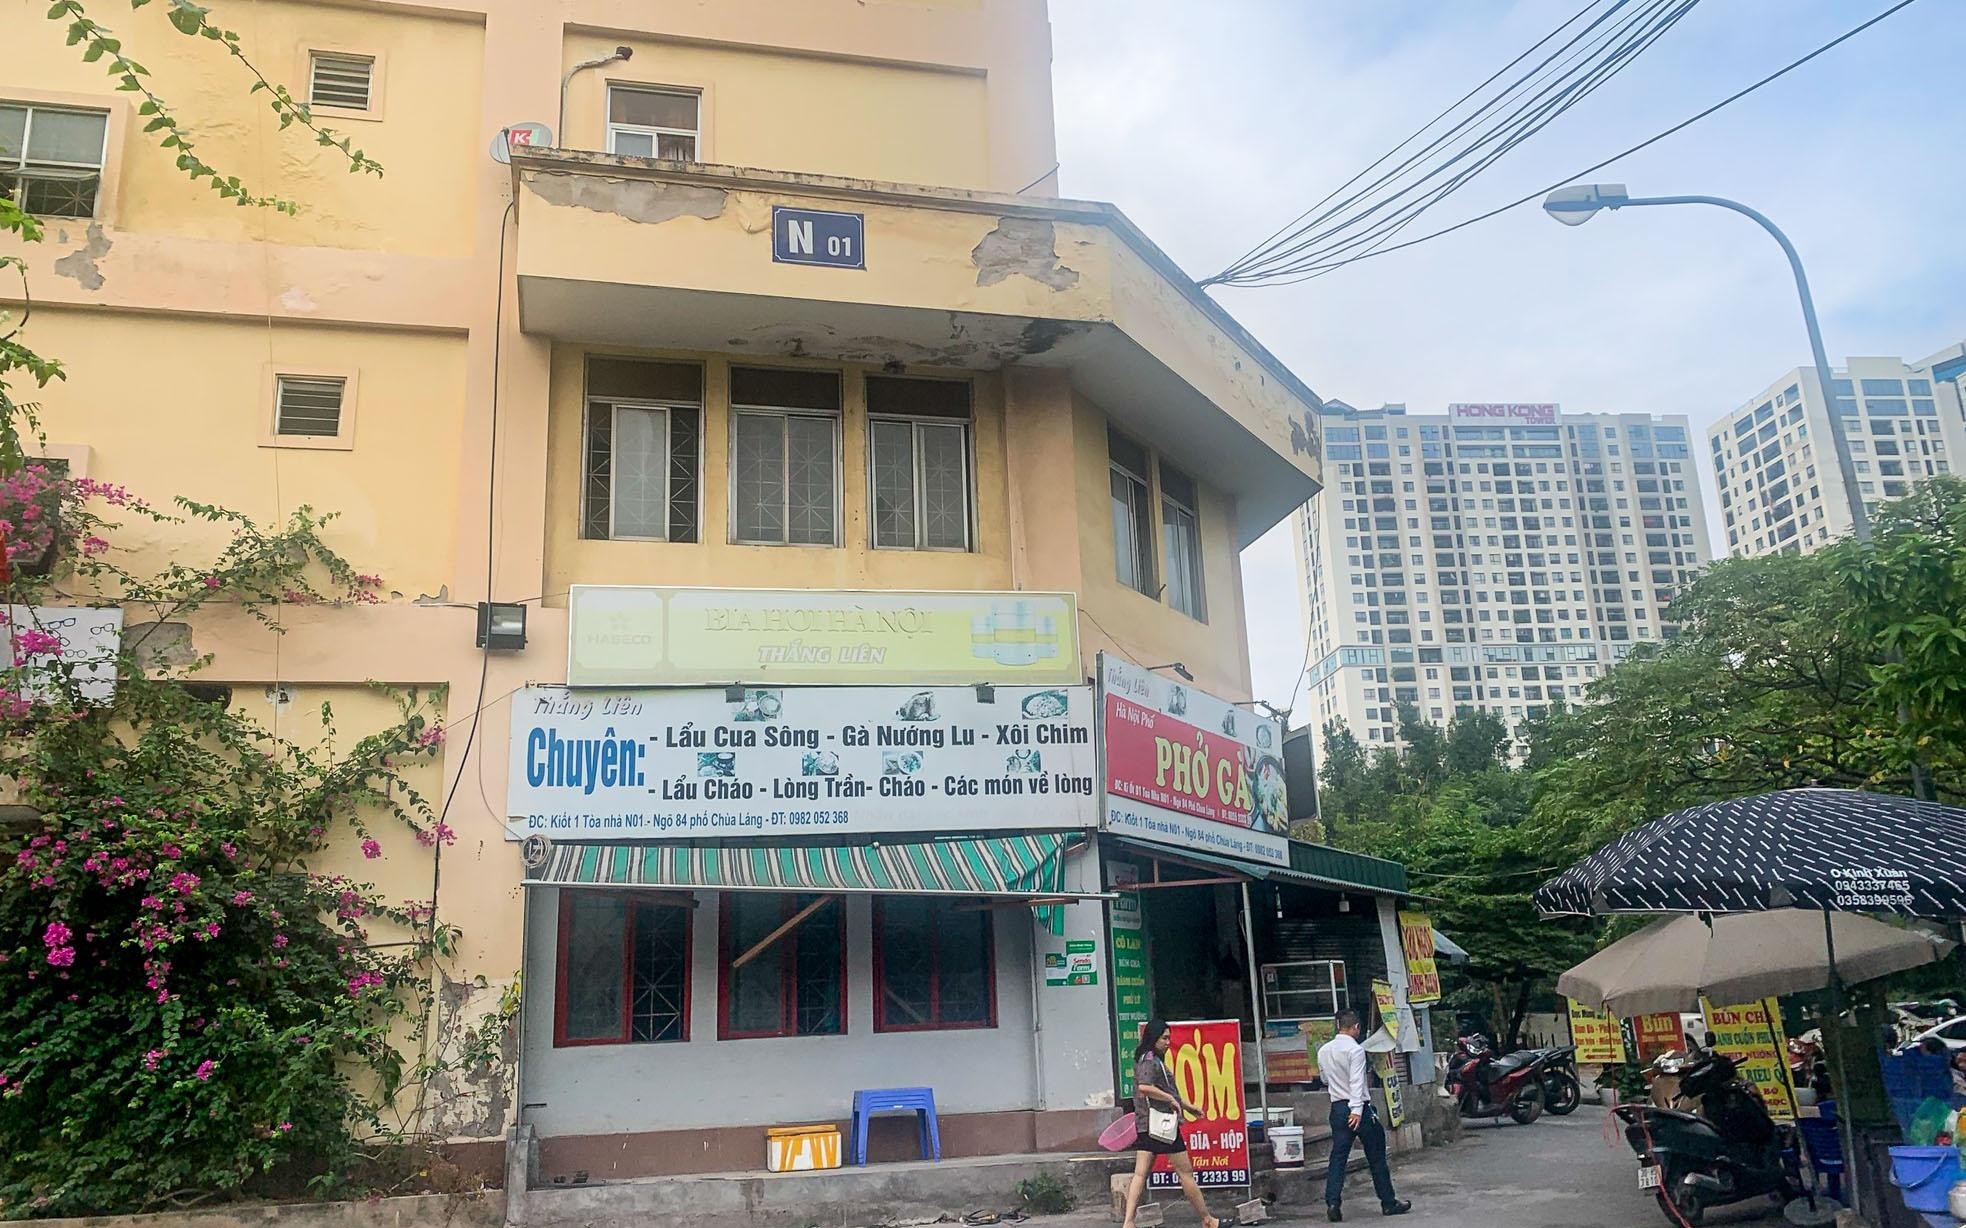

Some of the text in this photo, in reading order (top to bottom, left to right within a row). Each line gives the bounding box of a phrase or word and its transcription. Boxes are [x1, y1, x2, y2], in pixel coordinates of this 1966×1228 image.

[788, 219, 851, 257] N 01
[1456, 404, 1554, 417] HONG KONG
[838, 642, 887, 664] LIÊN
[1115, 702, 1127, 720] Hà
[666, 721, 706, 748] Lẩu
[714, 725, 756, 748] Cua
[764, 725, 819, 750] Sông
[842, 725, 870, 747] Gà
[877, 724, 945, 749] Nướng
[951, 725, 975, 746] Lu
[996, 723, 1029, 745] Xôi
[1036, 723, 1088, 744] Chim
[527, 726, 645, 795] Chuyên:
[1154, 730, 1253, 811] PHỞ GÀ
[662, 774, 697, 800] Lẩu
[704, 778, 753, 800] Cháo
[773, 777, 819, 801] Lòng
[879, 775, 925, 797] Cháo
[944, 774, 979, 796] Các
[984, 774, 1023, 795] món
[1029, 770, 1049, 794] về
[1055, 772, 1093, 796] lòng
[528, 814, 547, 829] ĐC:
[574, 815, 580, 828] 1
[676, 813, 688, 827] 84
[771, 811, 787, 826] ĐT:
[789, 810, 811, 825] 0982
[813, 810, 830, 825] 052
[832, 809, 849, 824] 368
[1190, 1130, 1211, 1150] ĐĨA
[1220, 1128, 1245, 1153] HỘP
[1152, 1172, 1170, 1185] ĐT:
[1202, 1171, 1230, 1183] 2333
[1231, 1170, 1246, 1182] 99
